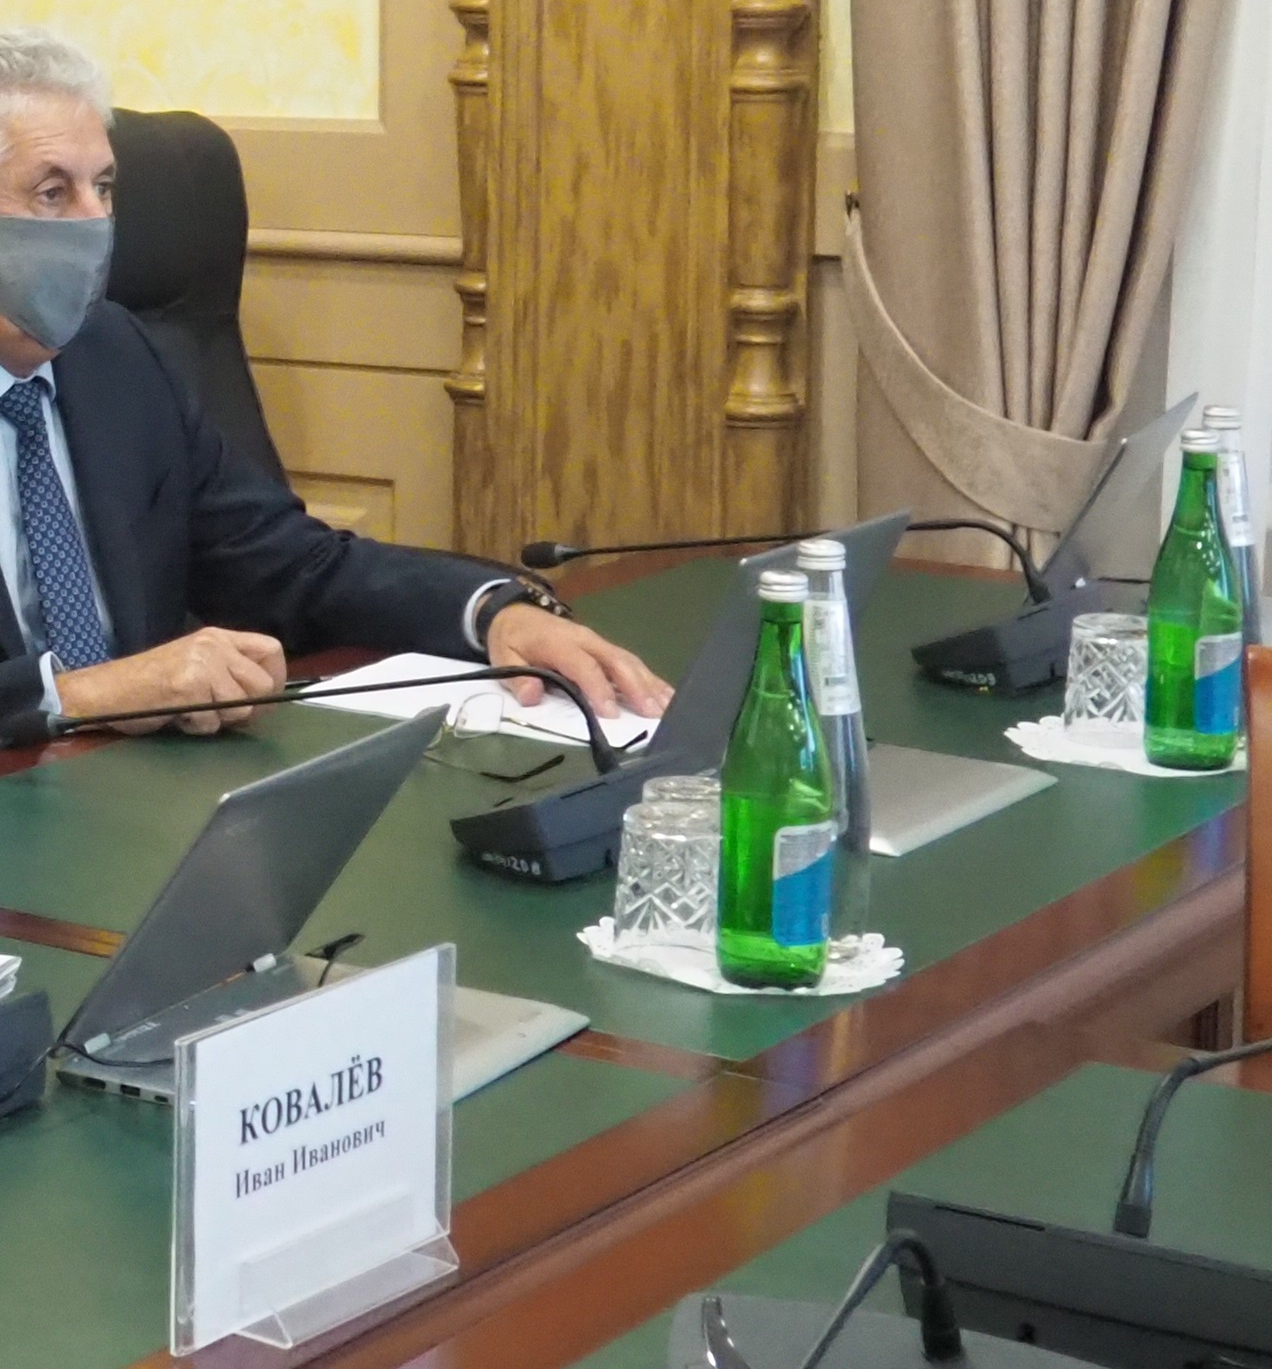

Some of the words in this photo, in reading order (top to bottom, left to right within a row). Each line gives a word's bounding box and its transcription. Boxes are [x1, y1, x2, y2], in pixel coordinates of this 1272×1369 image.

[239, 1054, 383, 1146] КОВАЛЁВ
[235, 1162, 286, 1200] Иван
[292, 1119, 386, 1176] Иванович
